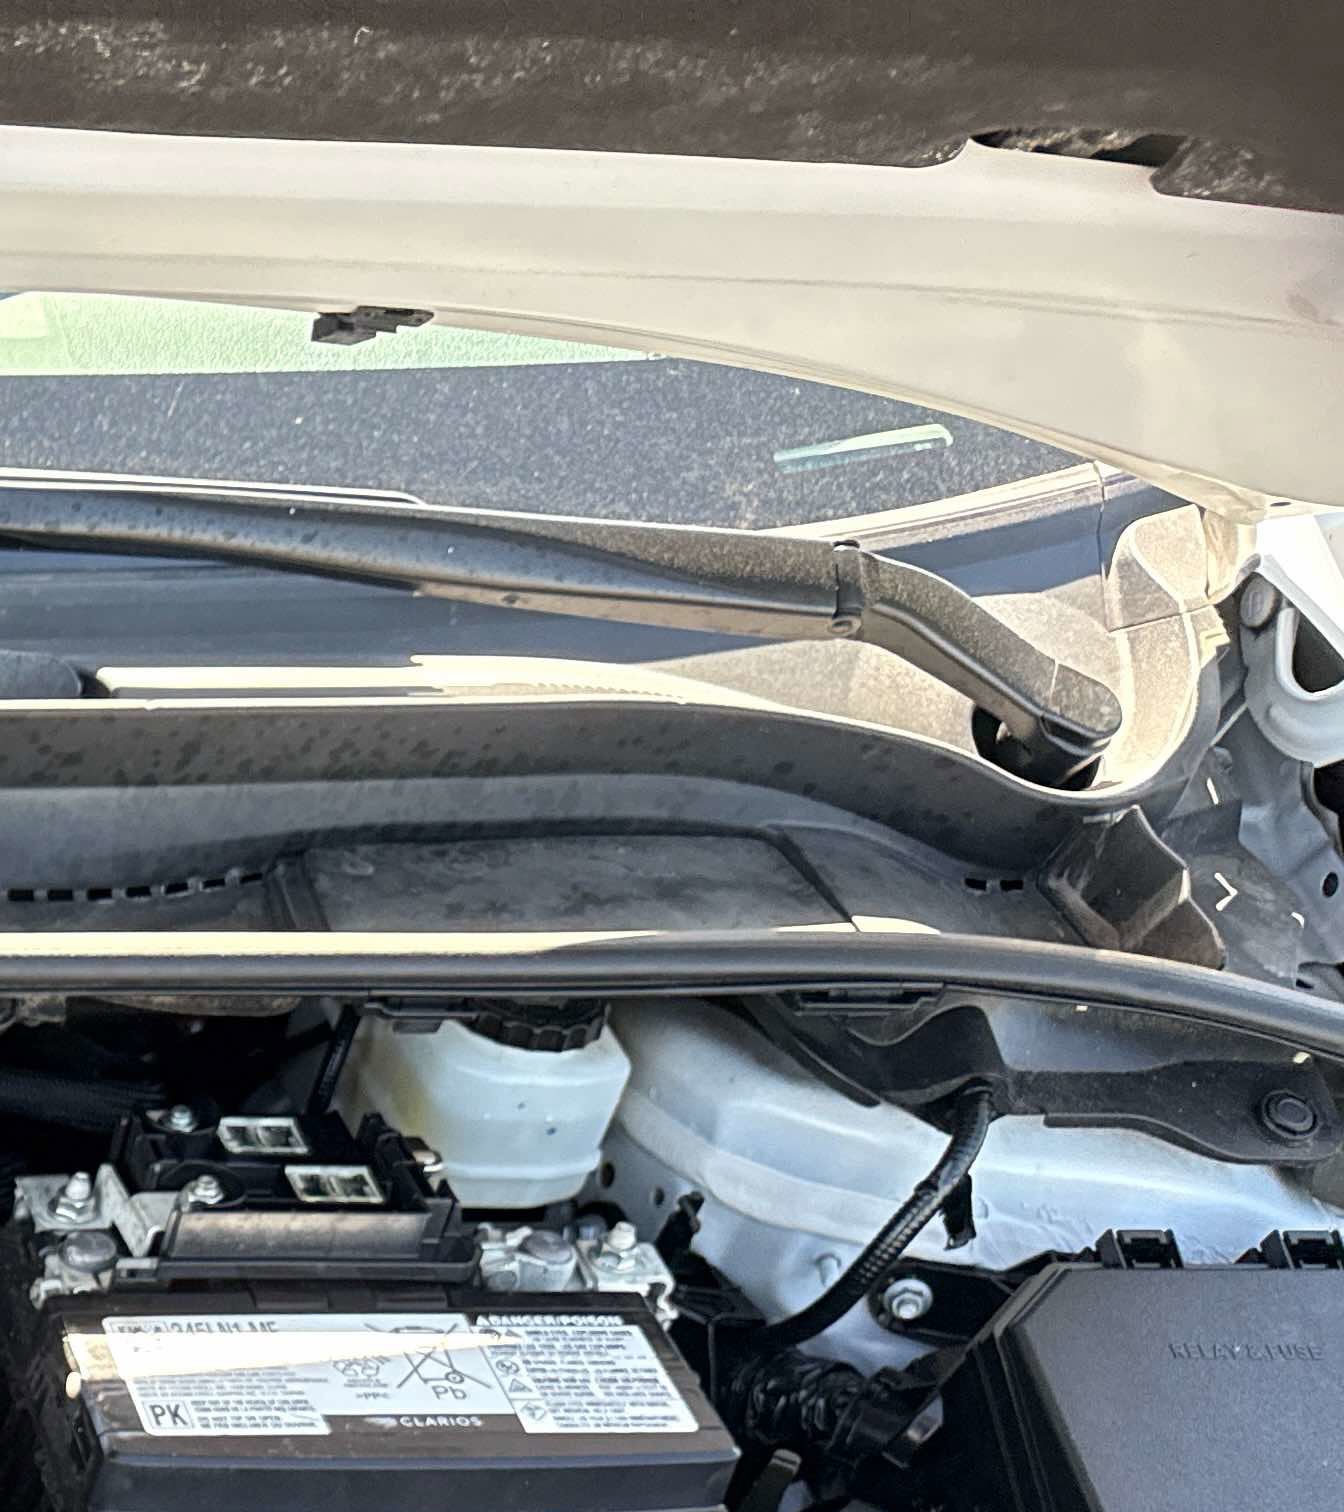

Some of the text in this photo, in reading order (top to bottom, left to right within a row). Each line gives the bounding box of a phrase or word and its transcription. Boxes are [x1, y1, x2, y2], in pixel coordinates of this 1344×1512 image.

[1168, 1342, 1243, 1361] RELAY
[1265, 1343, 1325, 1362] FUSE
[431, 1385, 468, 1401] Pb
[149, 1404, 190, 1428] PK
[398, 1414, 484, 1428] CLARIOS
